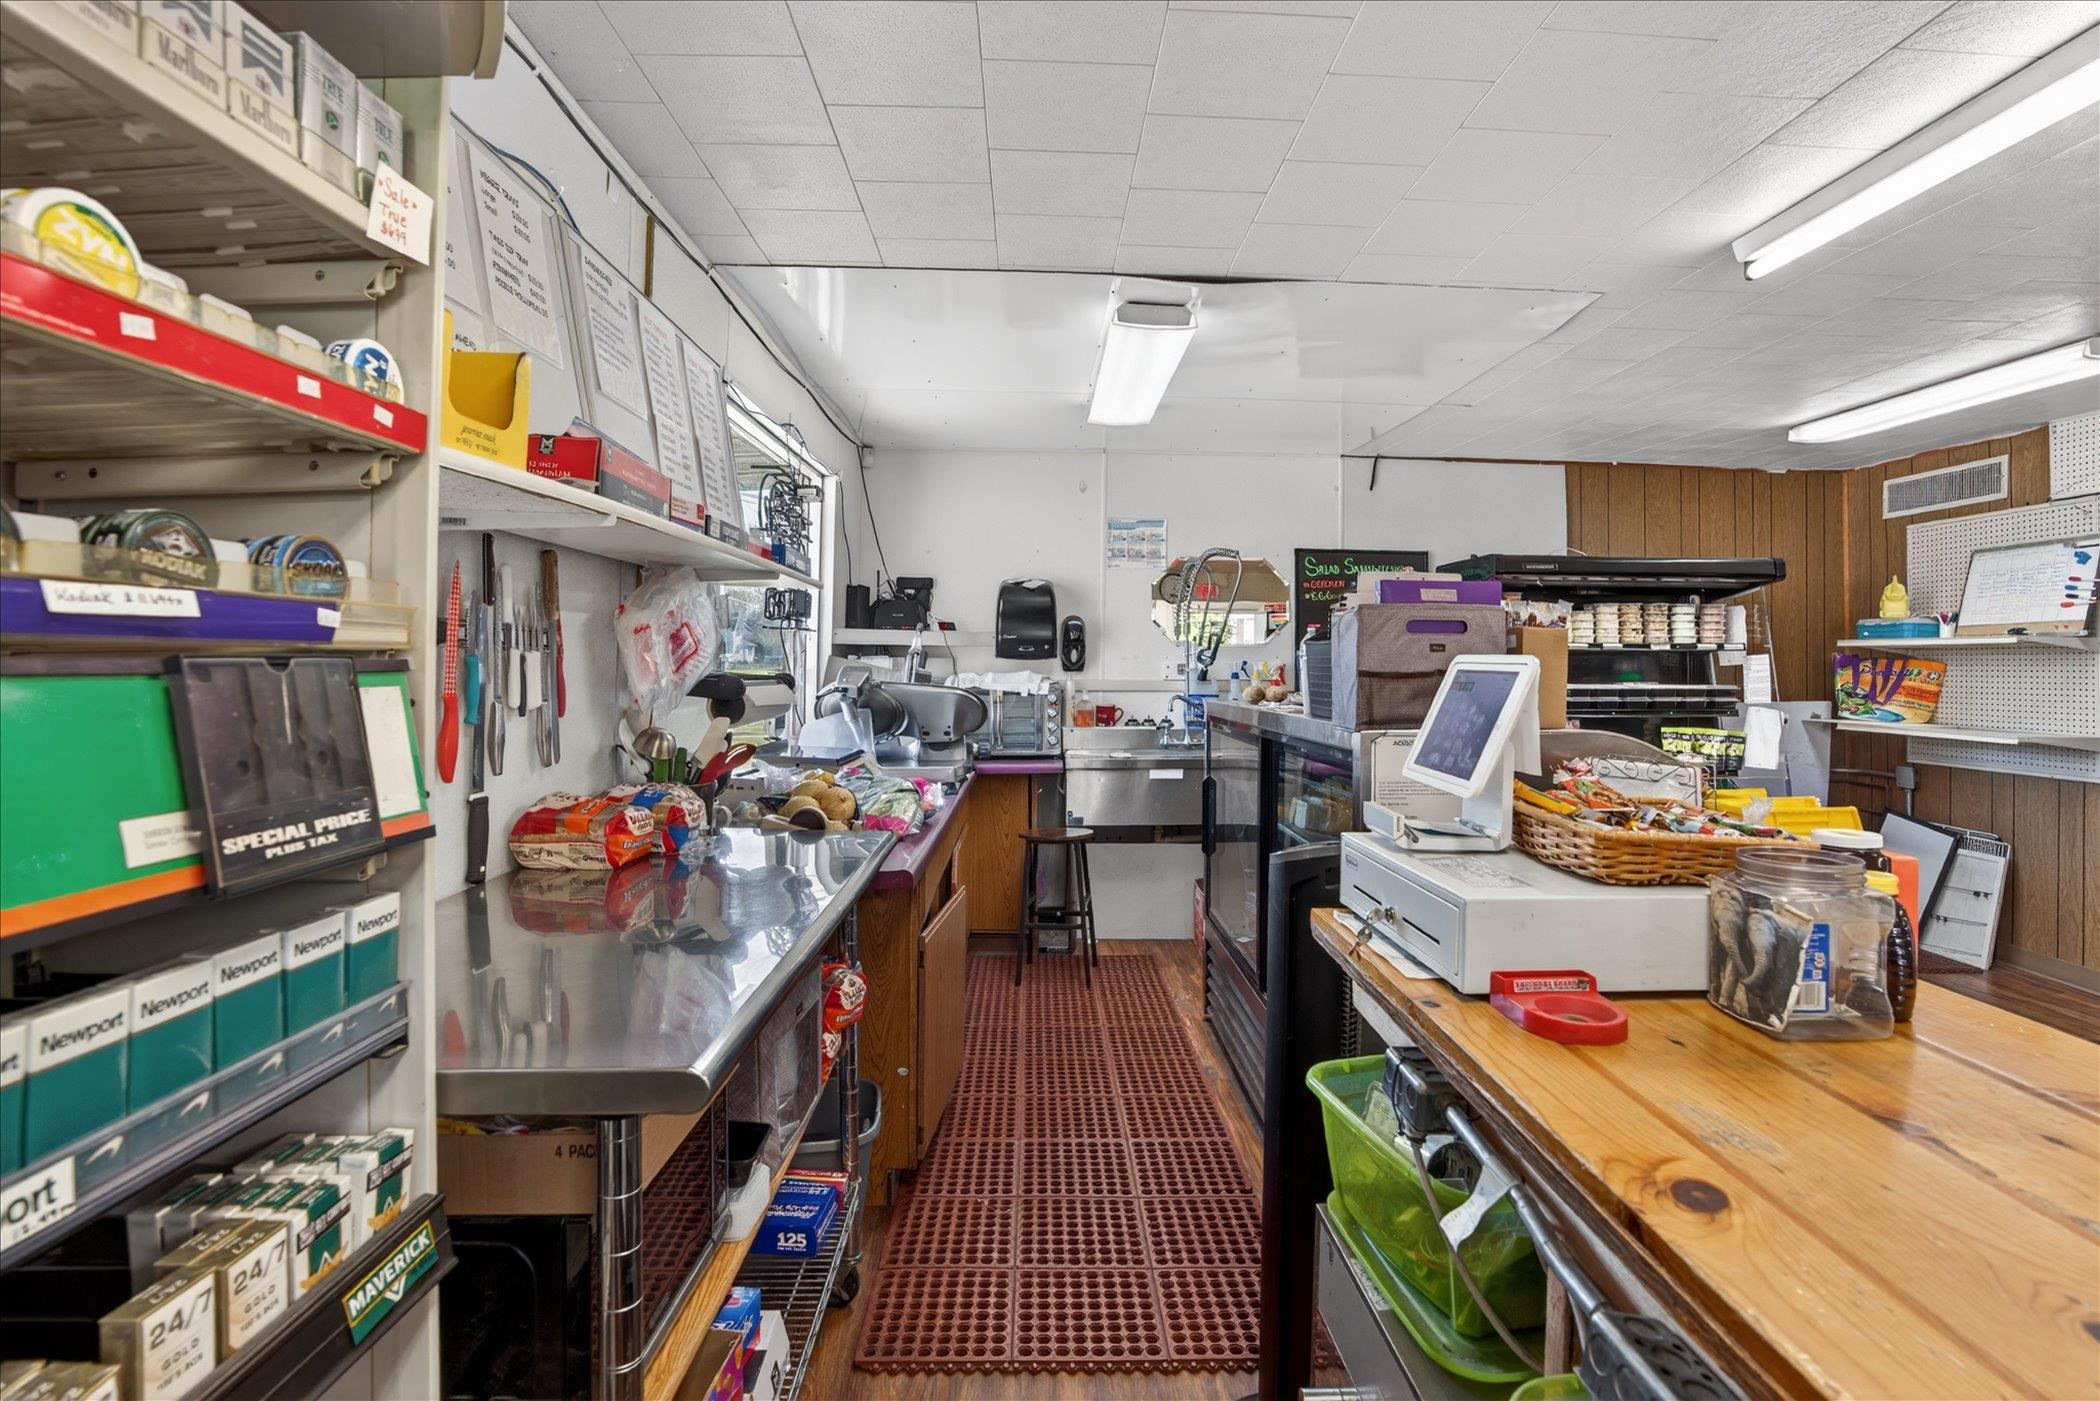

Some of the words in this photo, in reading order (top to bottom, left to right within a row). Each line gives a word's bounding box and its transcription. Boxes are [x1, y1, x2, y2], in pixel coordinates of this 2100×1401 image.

[158, 30, 219, 96] Marlboro
[240, 89, 292, 145] Marlboro
[52, 208, 129, 271] ZYN
[139, 547, 208, 581] KODIAK
[221, 821, 311, 856] SPECIAL
[314, 808, 372, 835] PRICE
[265, 842, 306, 860] PLUS
[309, 832, 339, 847] TAX
[358, 909, 398, 934] Newport
[294, 928, 342, 958] Newport
[220, 951, 278, 984] Newport
[141, 981, 210, 1019] Newport
[40, 1011, 125, 1056] Newport
[554, 1144, 564, 1160] 4
[569, 1143, 596, 1160] PAC
[0, 1178, 58, 1226] ort
[777, 1231, 807, 1247] 125
[234, 1240, 286, 1297] 24/7
[348, 1229, 431, 1318] MAVERICK
[151, 1286, 213, 1351] 24/7
[244, 1284, 276, 1315] GOLD
[161, 1337, 200, 1372] GOLD
